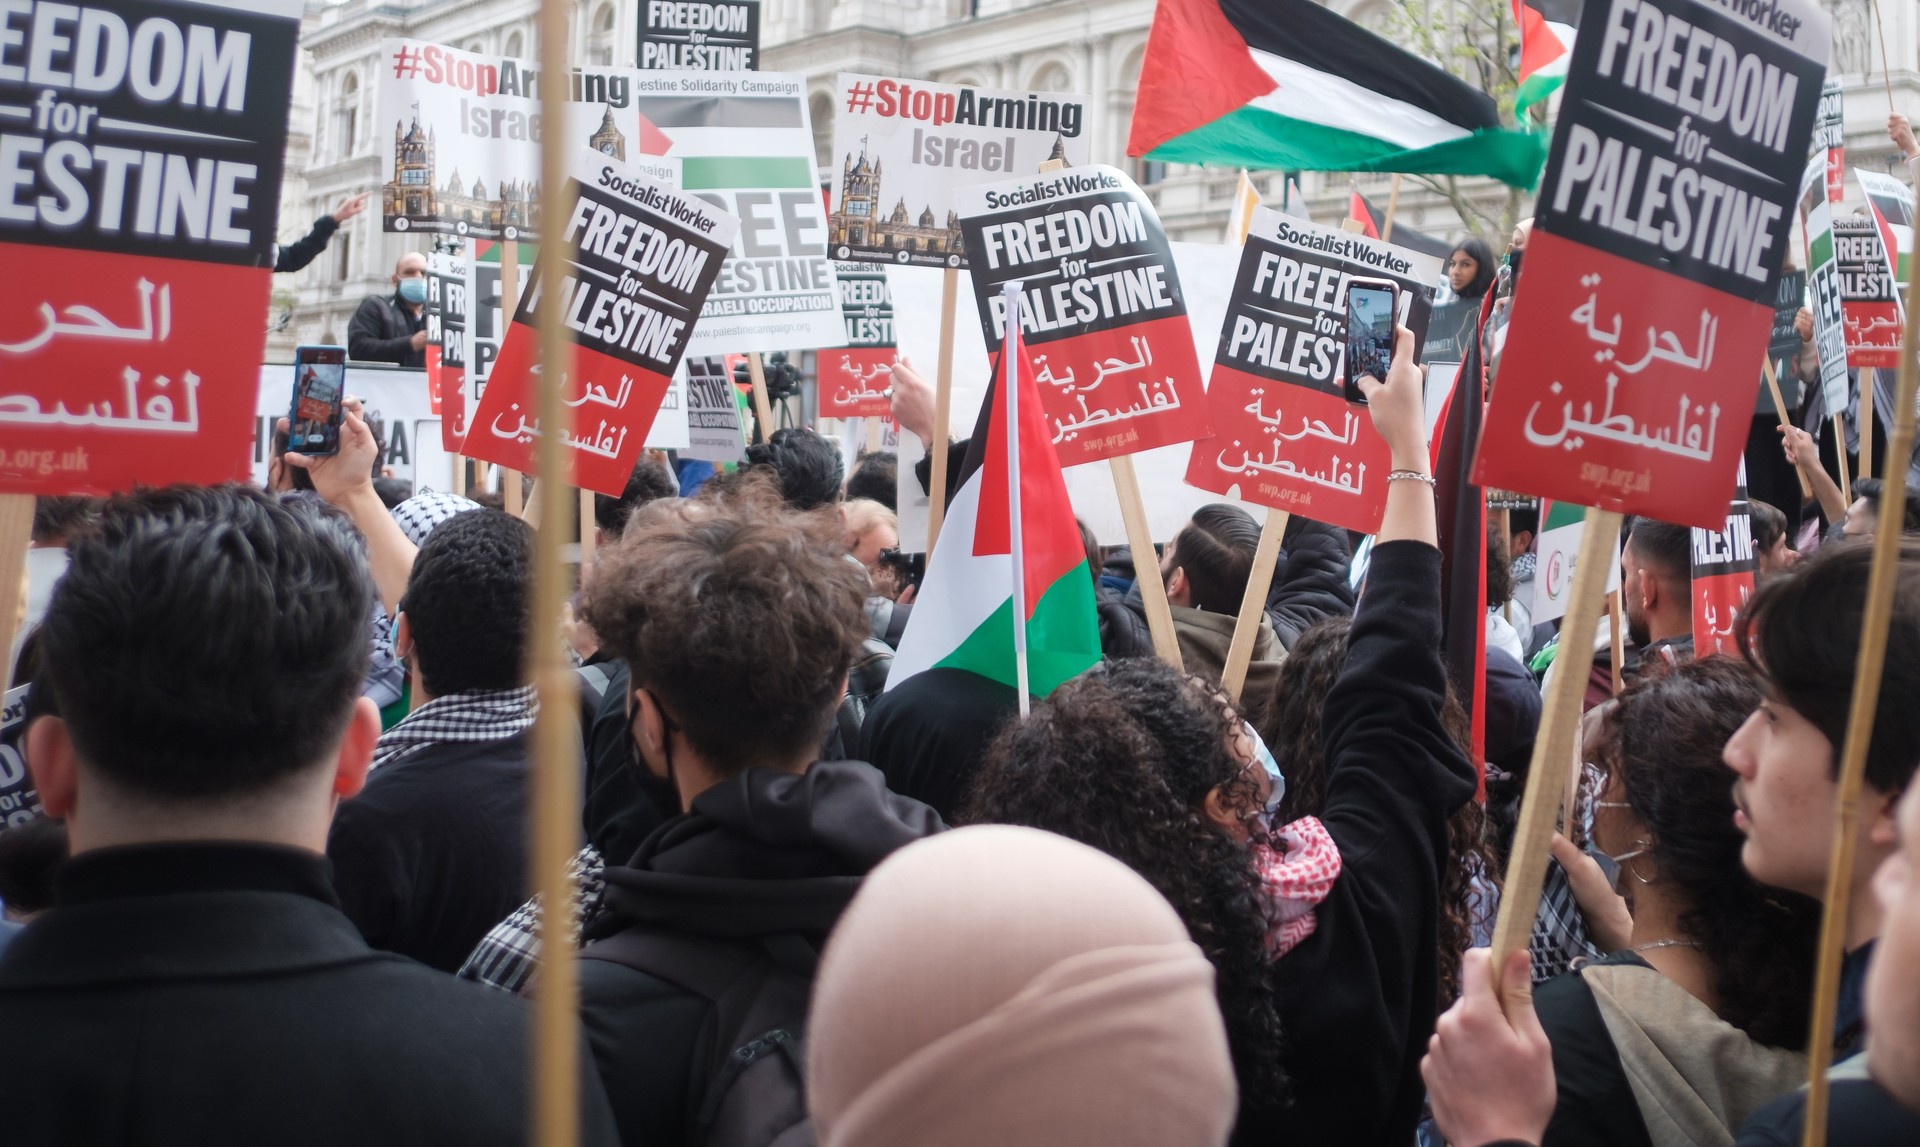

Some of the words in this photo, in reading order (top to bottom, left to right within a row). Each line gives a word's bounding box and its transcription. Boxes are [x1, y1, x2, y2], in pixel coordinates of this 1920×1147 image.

[648, 0, 748, 33] FREEDOM
[689, 30, 708, 44] for
[393, 45, 630, 109] #StopAring
[642, 42, 752, 71] PALESTINE
[1597, 0, 1798, 152] FREEDOM
[681, 79, 738, 94] Solidarity
[741, 80, 799, 94] Campaign
[847, 79, 1082, 137] #StopArming
[36, 89, 98, 135] for
[460, 98, 543, 145] Israe
[912, 128, 1015, 172] Israel
[1673, 115, 1710, 162] for
[0, 133, 257, 243] ESTINE
[1553, 123, 1782, 282] PALESTINE
[561, 196, 709, 295] FREEDOM
[982, 202, 1148, 270] FREEDOM
[616, 270, 643, 297] for
[708, 258, 831, 295] ESTINE
[1060, 257, 1088, 279] for
[1864, 260, 1879, 272] for
[748, 295, 832, 313] OCCUPATION
[865, 305, 880, 317] for
[988, 265, 1173, 340] PALESTINE
[1315, 311, 1341, 336] for
[1570, 273, 1718, 373] الحرية
[1034, 336, 1153, 394] الحرية
[1083, 428, 1139, 451] swp.org.uk
[1244, 388, 1359, 445] الحرية
[1524, 372, 1720, 462] لفلسطين
[1216, 438, 1366, 495] لفلسطين
[1580, 462, 1652, 494] swp.org.uk
[1259, 483, 1312, 505] swp.org.uk
